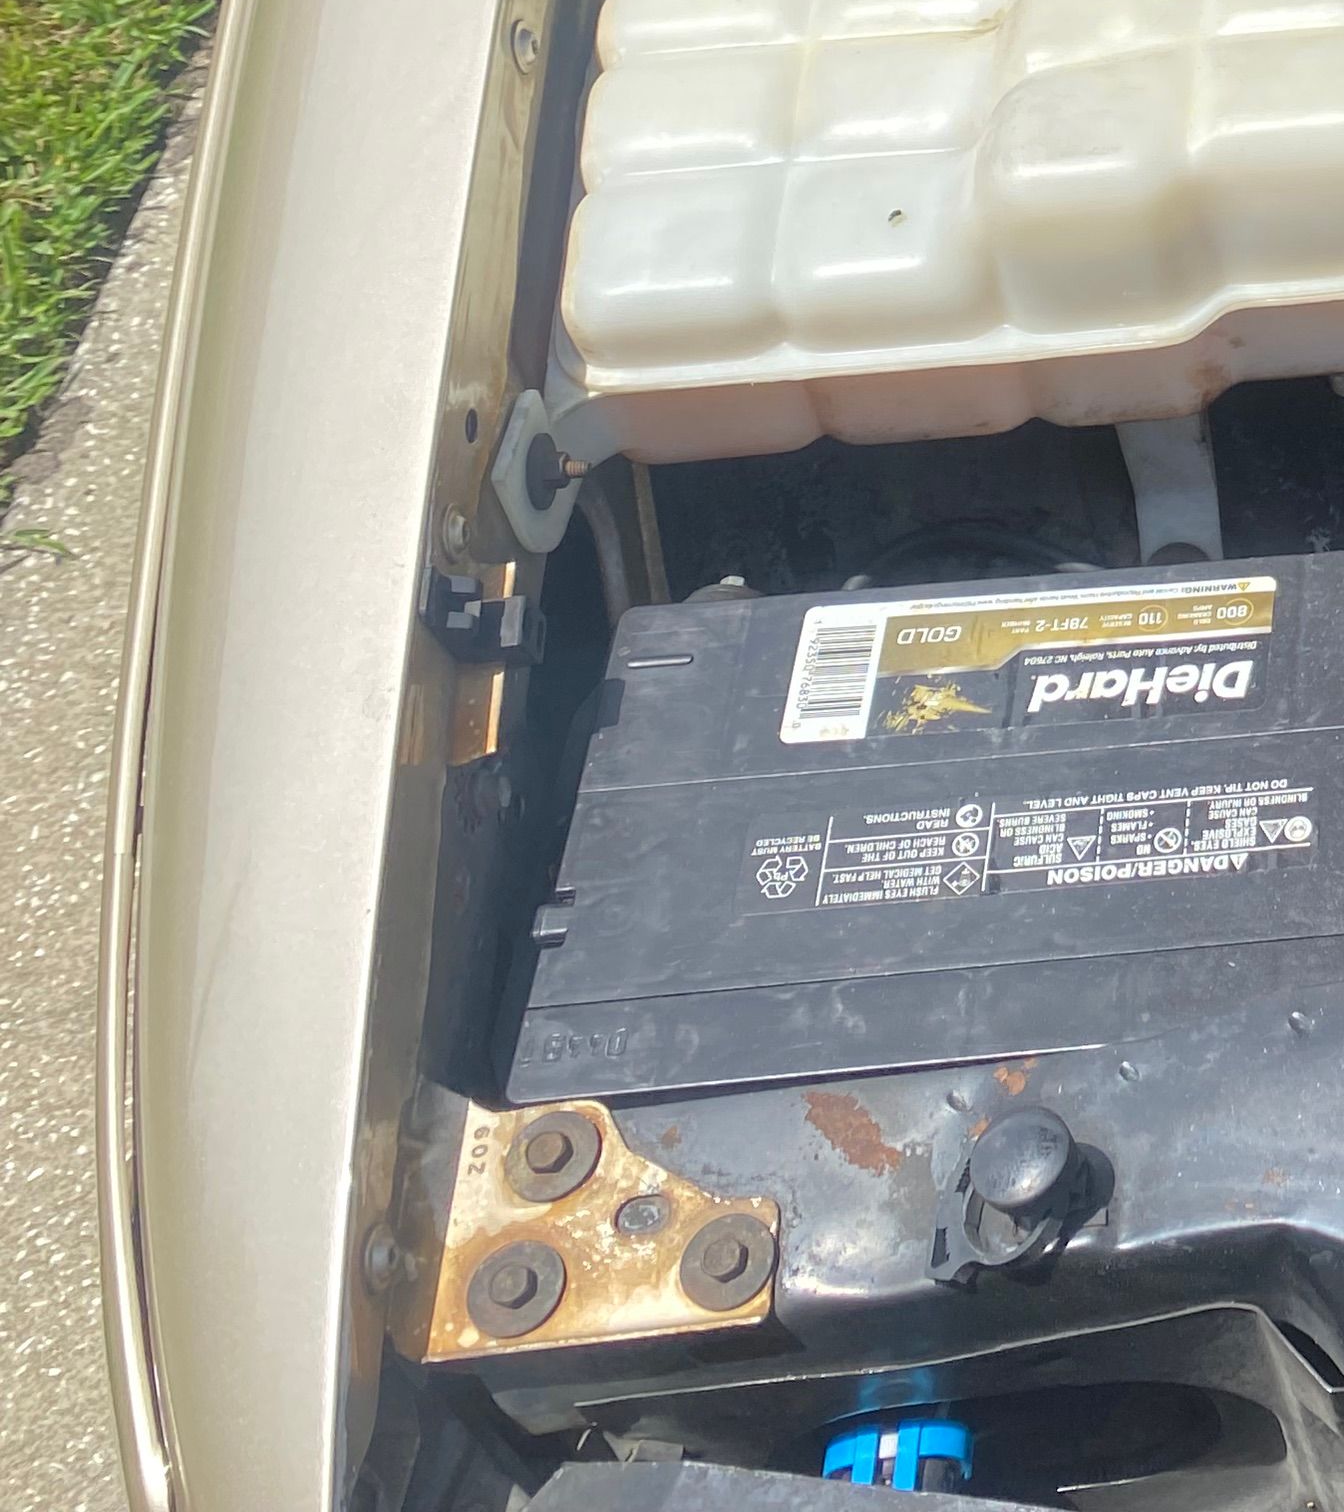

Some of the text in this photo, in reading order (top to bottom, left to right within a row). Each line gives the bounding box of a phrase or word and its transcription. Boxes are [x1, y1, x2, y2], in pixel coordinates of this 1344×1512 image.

[1180, 583, 1236, 593] WARNING:
[1216, 605, 1247, 618] 800
[1034, 616, 1088, 631] 78FT-2
[1138, 612, 1161, 625] 110
[895, 624, 962, 644] GOLD
[1154, 645, 1192, 656] Advance
[1194, 643, 1206, 653] by:
[1207, 640, 1257, 653] Distributed
[1053, 654, 1067, 663] NC
[1069, 650, 1104, 663] Raleigh,
[1132, 648, 1153, 658] Auto
[1024, 655, 1053, 665] 27604
[1024, 659, 1255, 712] DieHard
[1244, 780, 1268, 791] NOT
[1270, 778, 1287, 788] DO
[1125, 790, 1156, 800] CAPS
[1157, 787, 1188, 797] VENT
[1190, 784, 1220, 795] KEEP
[1022, 798, 1062, 809] LEVEL.
[1063, 796, 1088, 806] AND
[1090, 792, 1123, 803] TIGHT
[1206, 792, 1307, 809] BLINDNESS OR INJURY.
[862, 808, 950, 823] INSTRUCTIONS.
[1106, 808, 1148, 820] SMOKING
[1207, 806, 1257, 818] CAN CAUSE
[915, 818, 948, 829] READ
[996, 813, 1066, 827] SEVERE BURNS.
[1110, 820, 1147, 831] FLAMES
[1224, 816, 1257, 827] GASES
[999, 822, 1065, 836] BLINDNESS OR
[1201, 826, 1256, 838] EXPLOSIVE
[755, 834, 819, 846] BE RECYCLED
[1012, 832, 1064, 844] CAN CAUSE
[1110, 832, 1146, 843] SPARKS
[1191, 836, 1255, 849] SHIELD EYES.
[750, 842, 821, 855] BATTERY MUST
[844, 836, 945, 853] REACH OF CHILDREN.
[1038, 843, 1062, 853] ACID
[1135, 844, 1151, 854] NO
[861, 846, 944, 862] KEEP OUT OF THE
[1012, 852, 1062, 866] SULFURIC
[831, 865, 941, 883] GET MEDICAL HELP FAST.
[1045, 853, 1229, 884] DANGER/POISON
[774, 871, 788, 880] Pb
[880, 876, 940, 888] WITH WATER.
[822, 885, 938, 903] FLUSH EYES IMMEDIATELY
